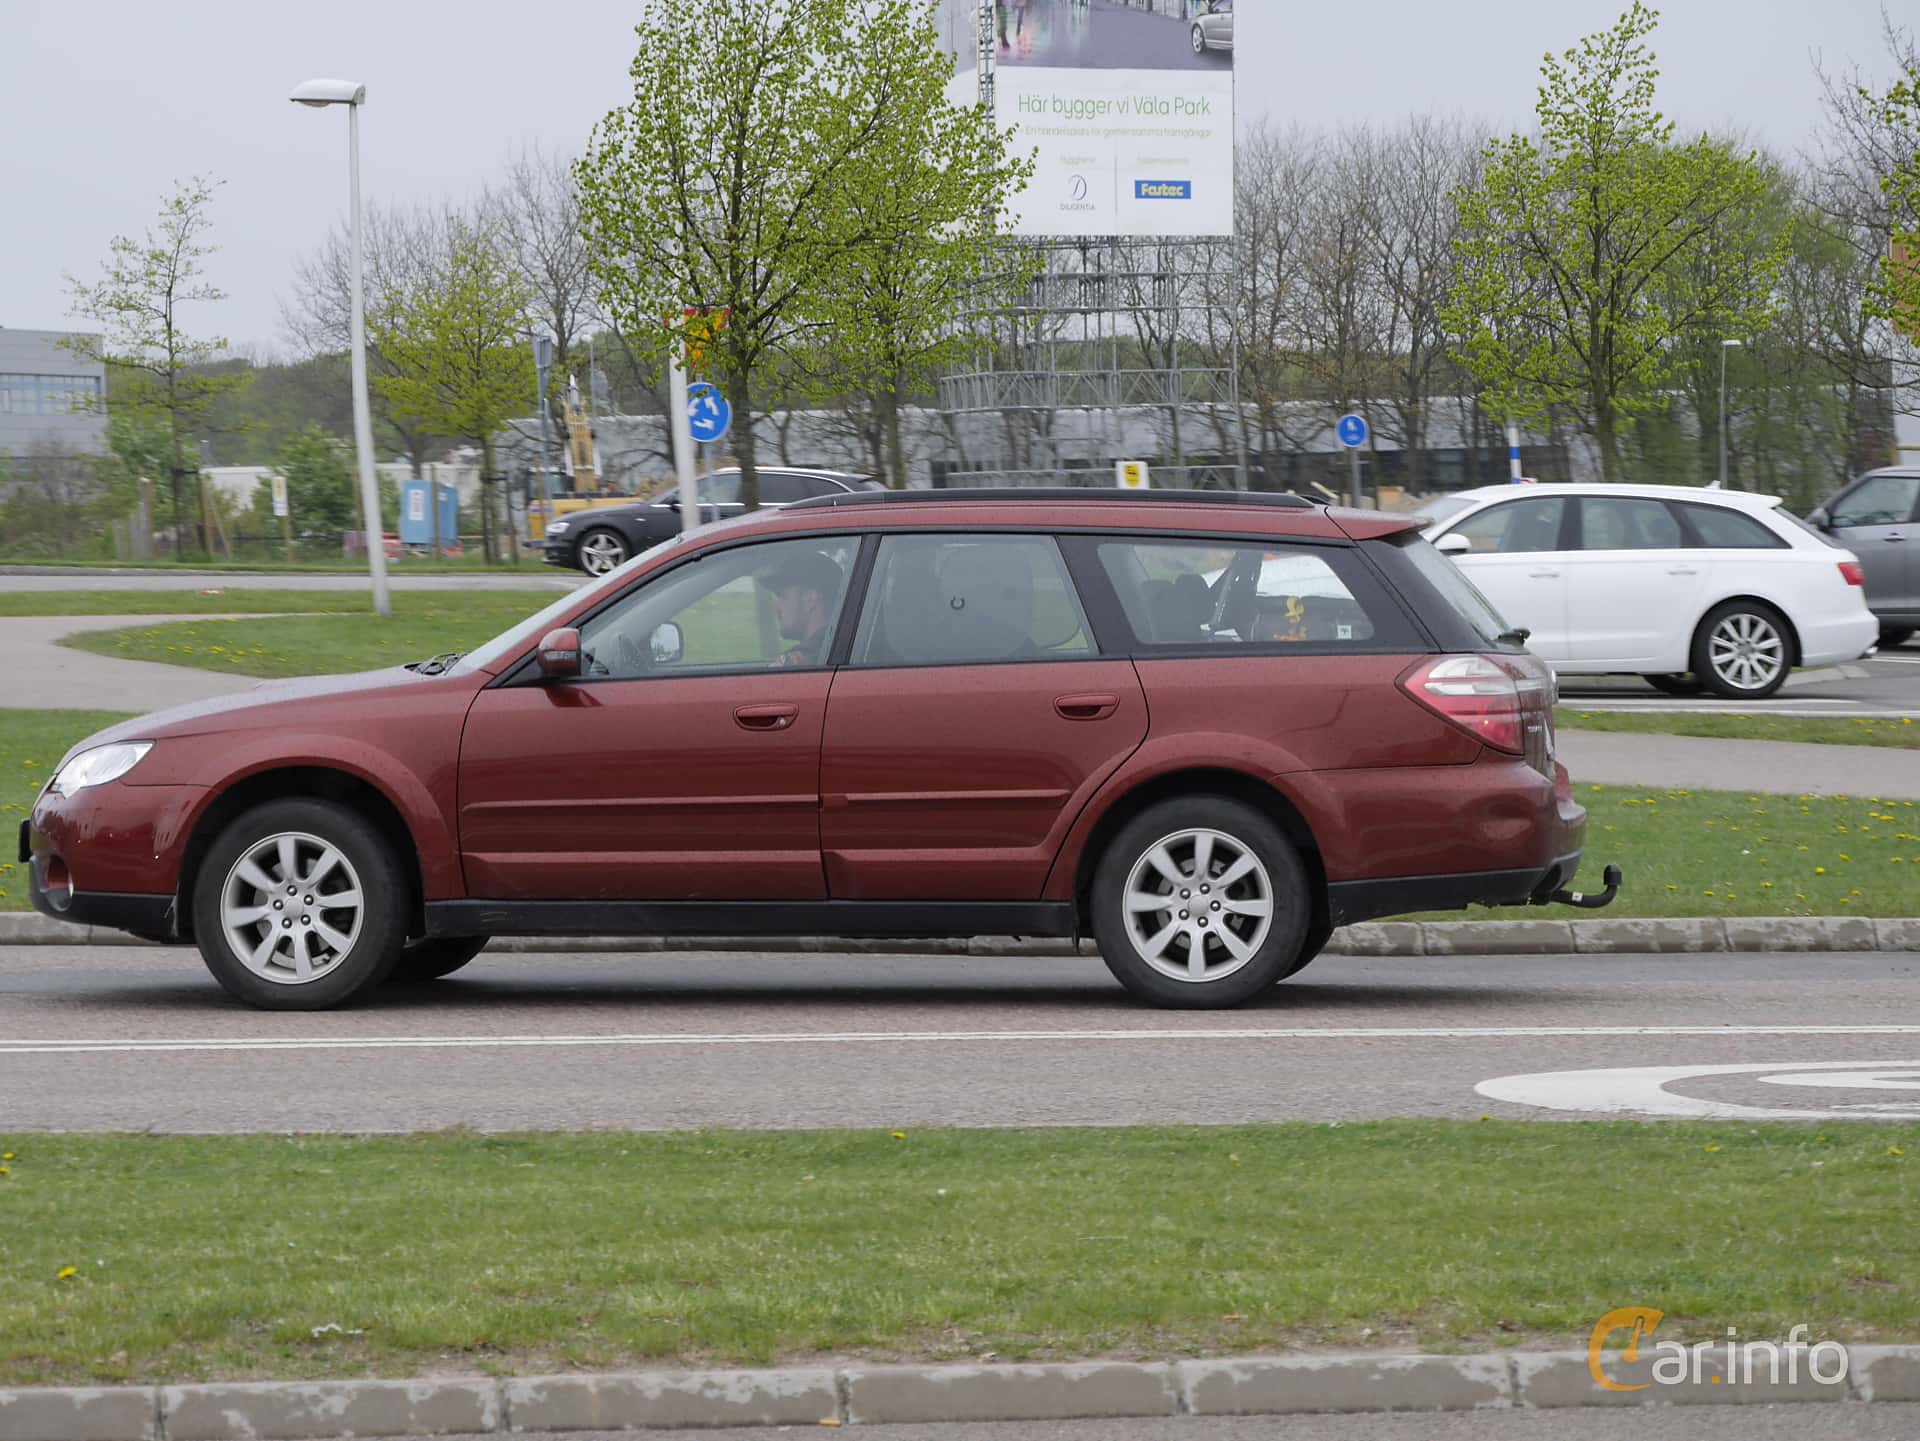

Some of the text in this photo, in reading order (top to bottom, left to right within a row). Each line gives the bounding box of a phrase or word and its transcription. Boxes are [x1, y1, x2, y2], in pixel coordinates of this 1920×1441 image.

[1018, 94, 1211, 120] Här bygger vi Väla Park
[1141, 183, 1184, 197] Fastec
